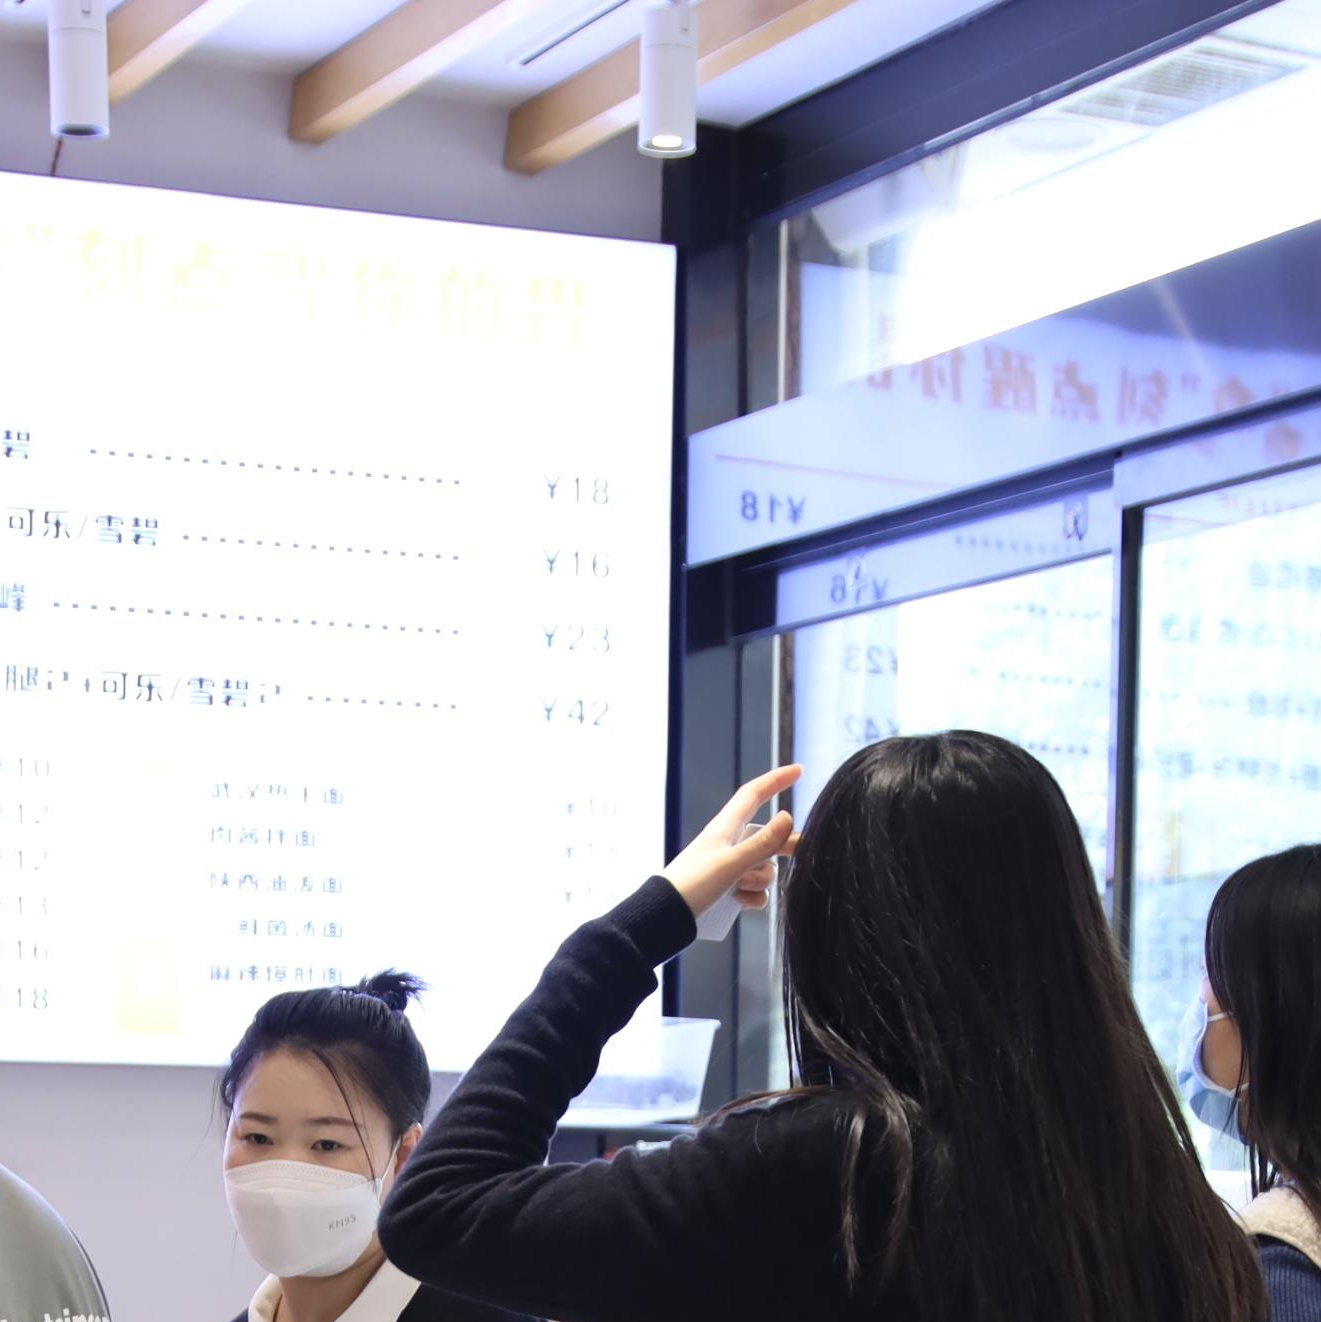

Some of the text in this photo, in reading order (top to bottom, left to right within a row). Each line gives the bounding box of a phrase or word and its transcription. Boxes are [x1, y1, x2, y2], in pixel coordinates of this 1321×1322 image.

[544, 473, 610, 505] ¥18
[541, 624, 611, 654] ¥23
[539, 697, 610, 727] ¥42
[328, 1214, 357, 1231] KN95
